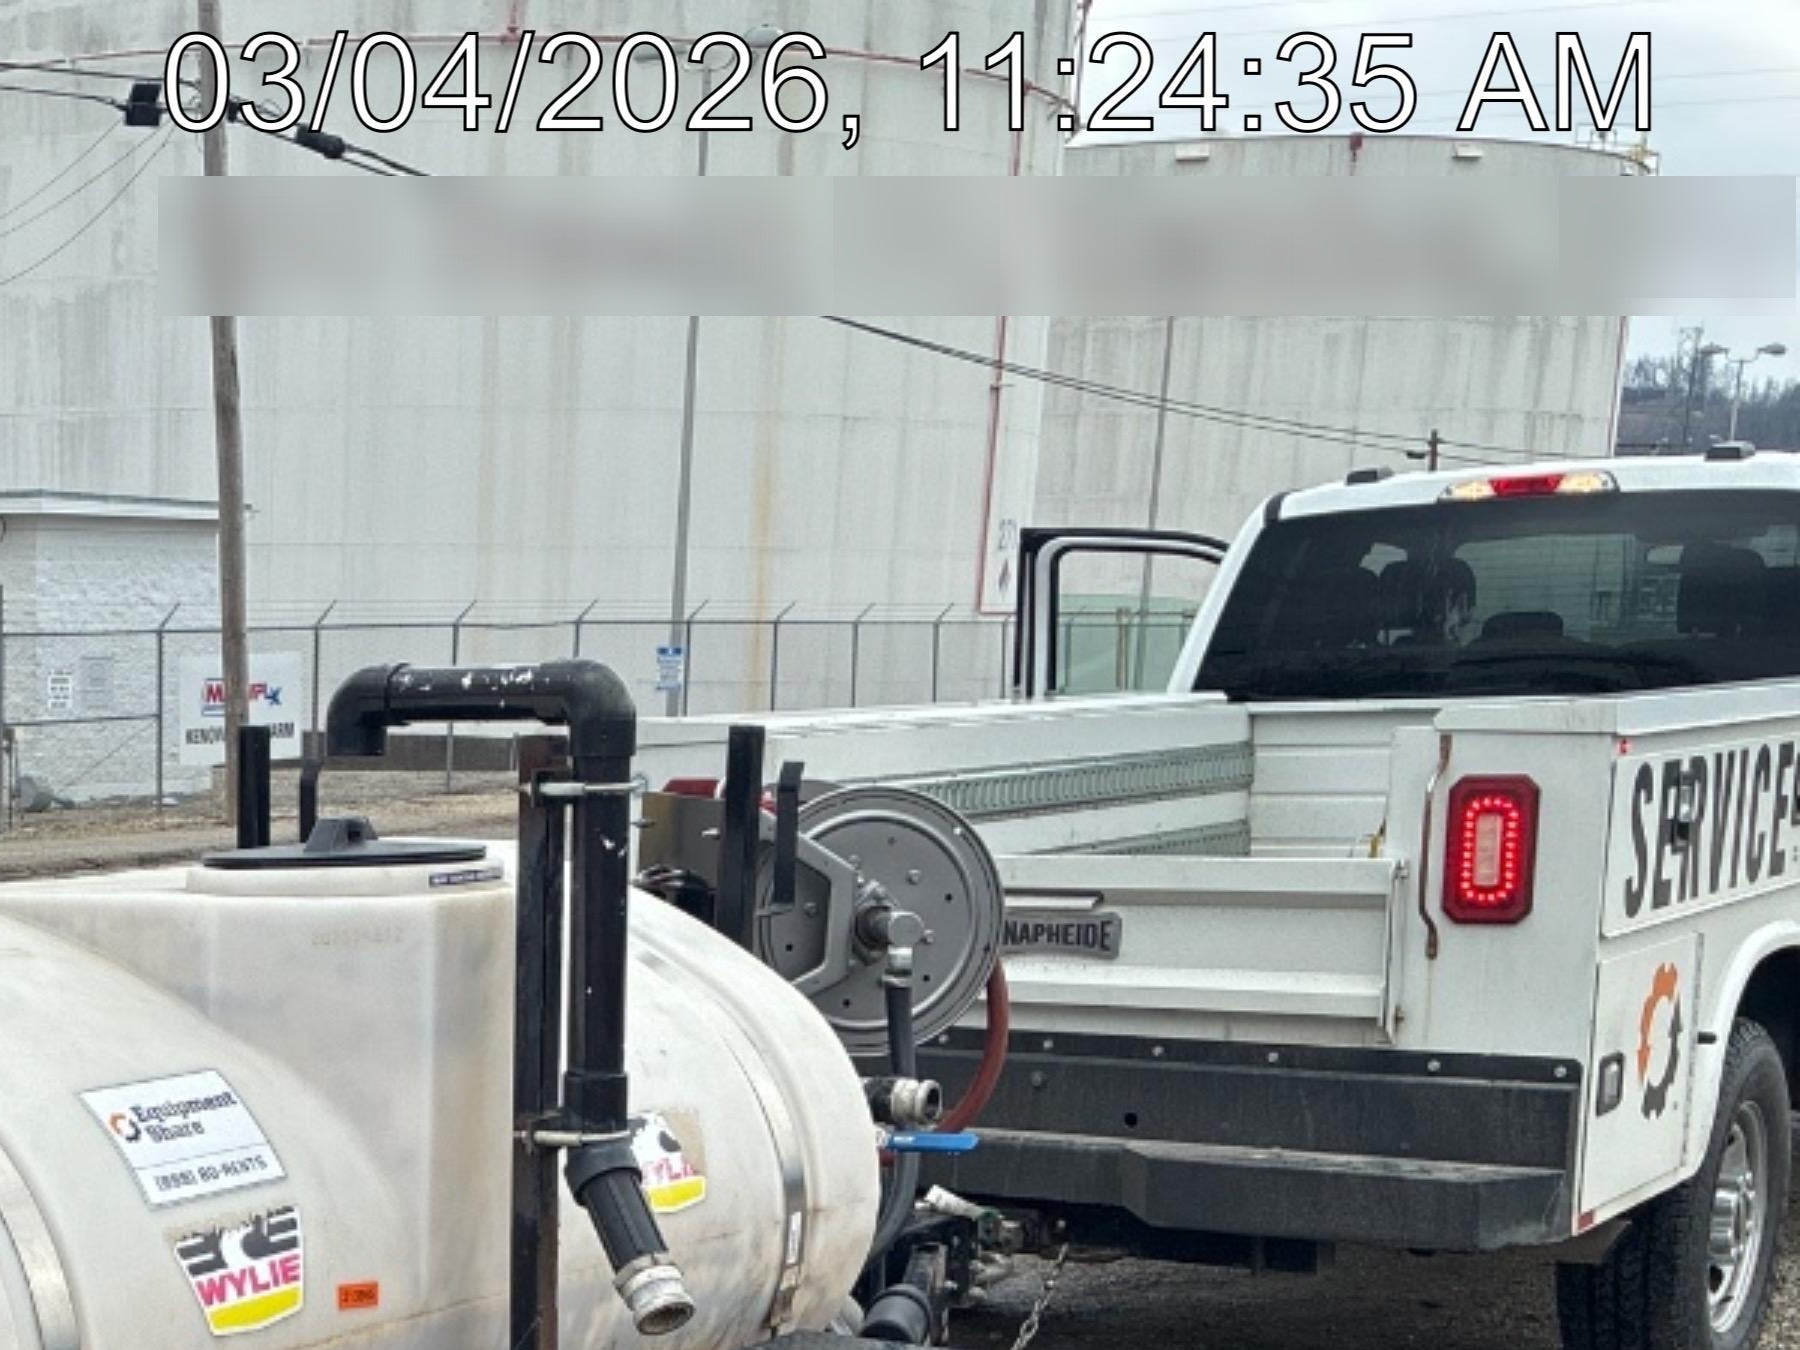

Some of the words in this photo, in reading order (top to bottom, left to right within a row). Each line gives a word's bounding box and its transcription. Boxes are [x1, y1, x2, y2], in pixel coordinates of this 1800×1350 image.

[185, 727, 225, 744] KENOV
[269, 722, 295, 738] ARM
[1624, 740, 1795, 918] SERVICE
[1002, 919, 1113, 951] NAPHEIDE
[130, 1091, 237, 1123] Equipment
[144, 1120, 205, 1143] Share
[196, 1253, 301, 1306] WYLIE
